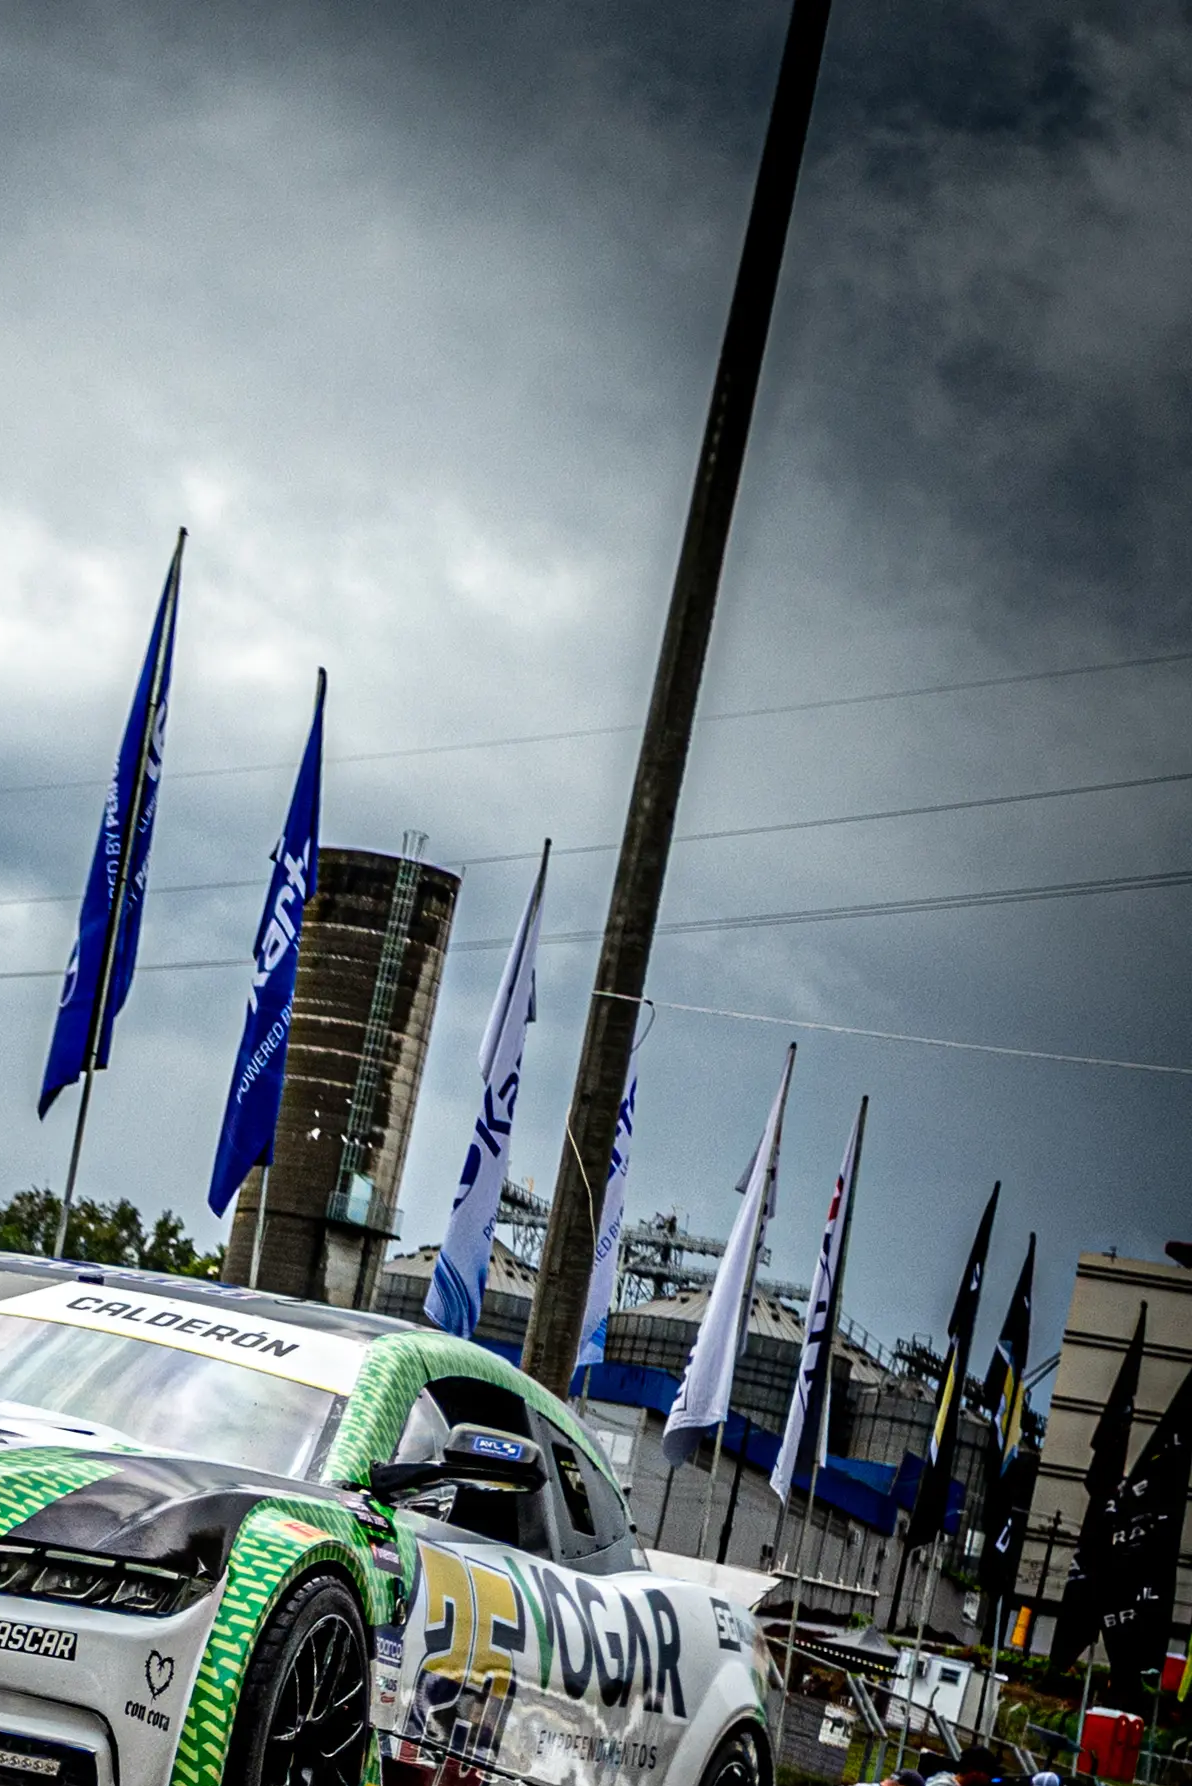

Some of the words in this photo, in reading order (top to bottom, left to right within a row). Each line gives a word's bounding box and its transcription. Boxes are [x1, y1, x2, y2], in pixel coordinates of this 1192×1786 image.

[65, 1296, 301, 1358] CALDERÓN
[377, 1636, 402, 1660] parco
[503, 1555, 687, 1719] YOGAR
[124, 1700, 147, 1722] con
